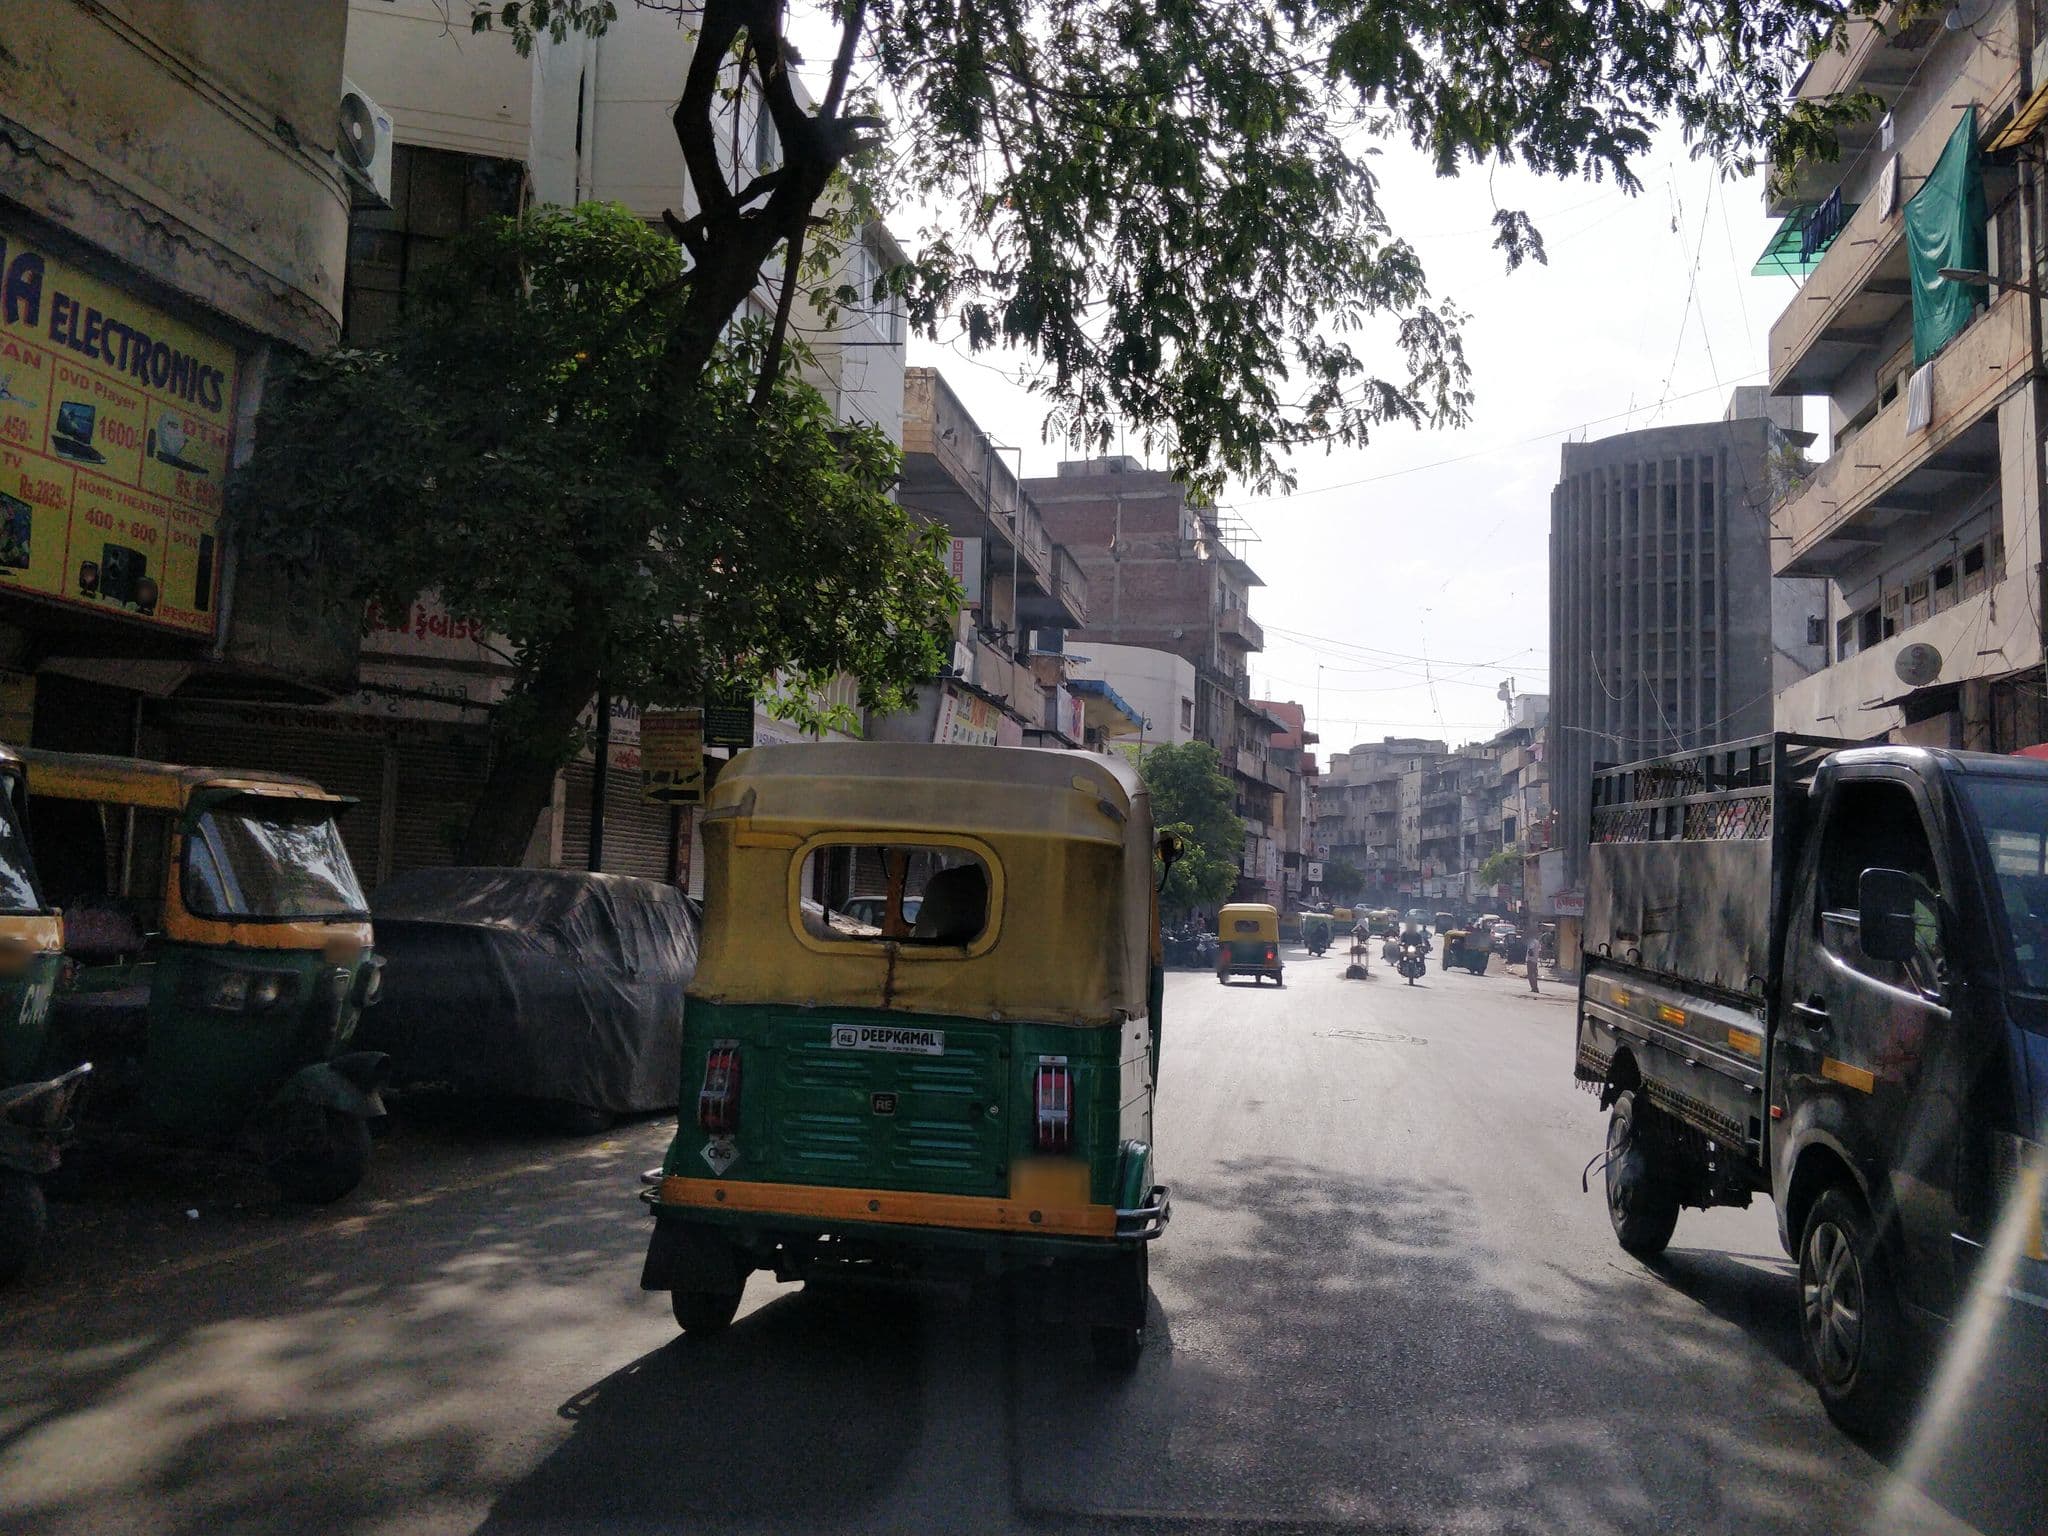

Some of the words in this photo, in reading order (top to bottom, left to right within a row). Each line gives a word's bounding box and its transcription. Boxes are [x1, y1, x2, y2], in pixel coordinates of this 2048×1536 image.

[0, 238, 45, 328] A
[49, 290, 225, 414] ELECTRONICS
[59, 367, 89, 390] DVD
[94, 381, 136, 411] Player
[3, 451, 22, 468] TV
[79, 479, 113, 501] HOME
[85, 507, 114, 530] 400
[861, 1028, 937, 1047] DEEPKAMAL
[874, 1098, 894, 1111] RE
